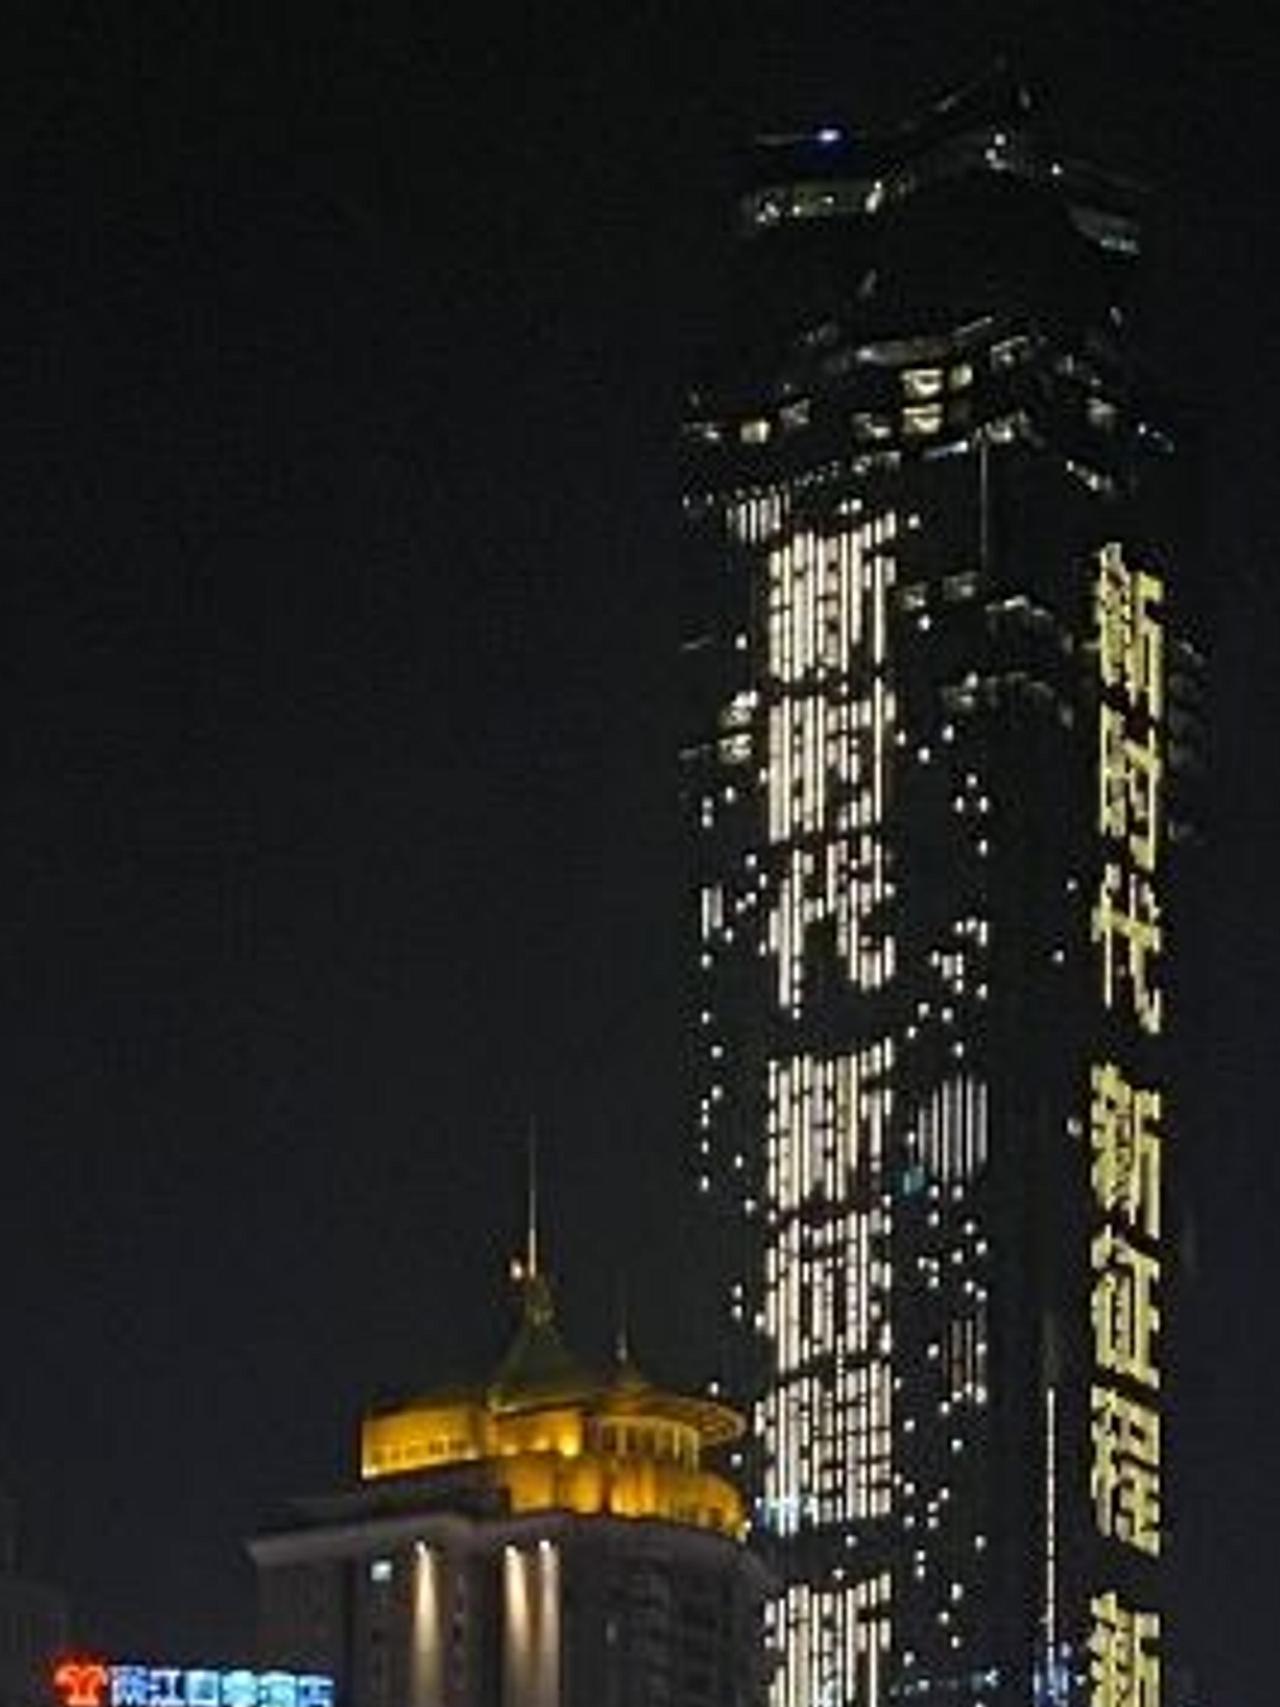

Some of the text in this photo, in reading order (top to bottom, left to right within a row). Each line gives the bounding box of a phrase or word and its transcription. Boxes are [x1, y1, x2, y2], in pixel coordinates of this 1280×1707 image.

[1091, 543, 1163, 1033] 新时代
[1090, 1063, 1161, 1556] 新征程
